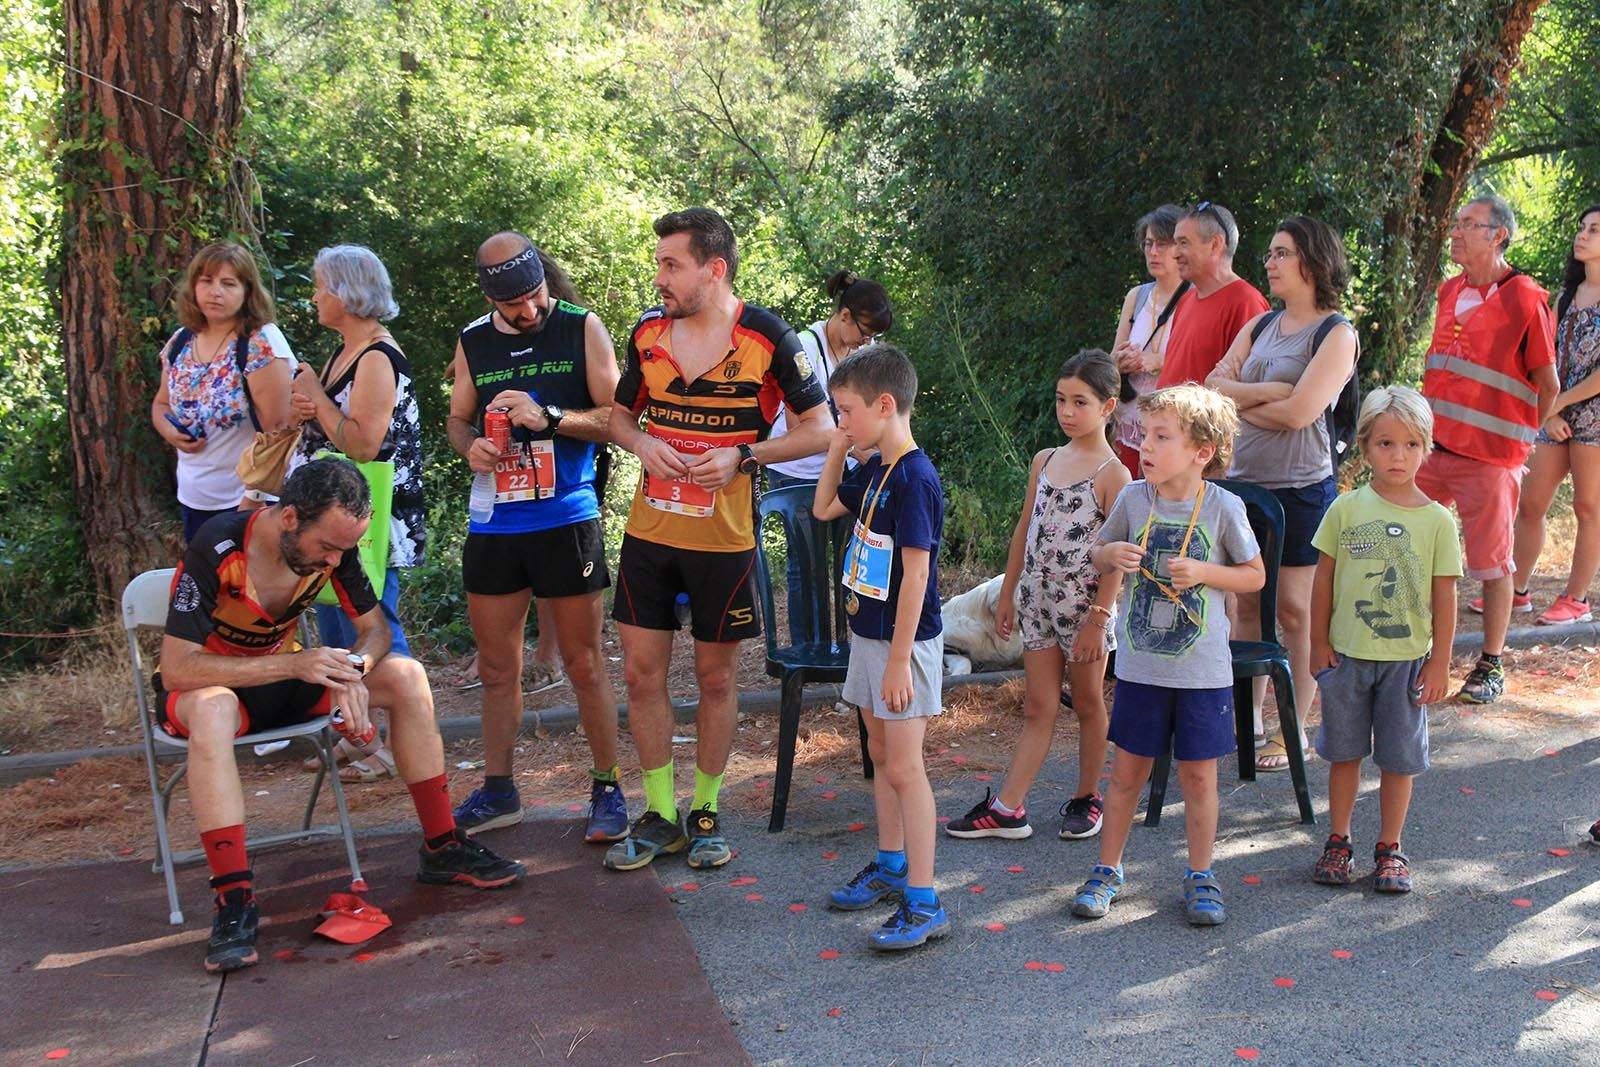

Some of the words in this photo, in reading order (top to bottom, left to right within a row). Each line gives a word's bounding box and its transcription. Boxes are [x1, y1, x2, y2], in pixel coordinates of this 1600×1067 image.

[486, 249, 534, 276] WONG
[518, 363, 538, 378] TO
[540, 360, 574, 375] RUN
[649, 405, 736, 427] SPIRIDON
[509, 474, 529, 489] 22
[670, 485, 681, 501] 3
